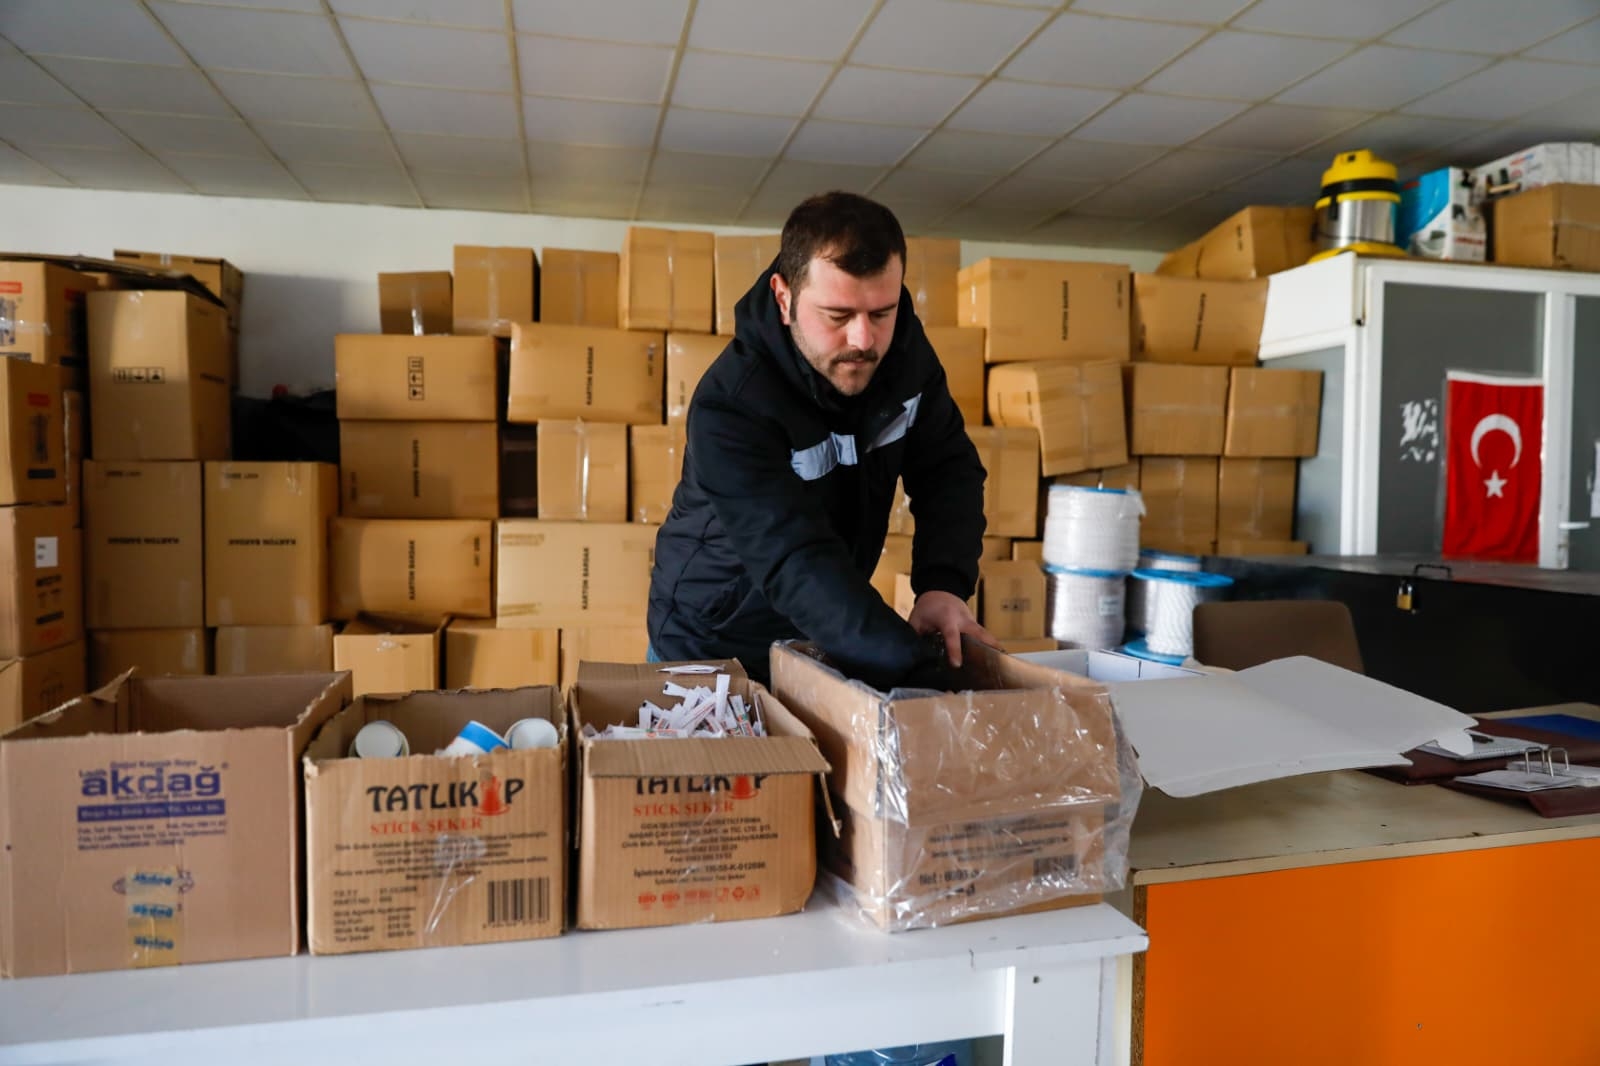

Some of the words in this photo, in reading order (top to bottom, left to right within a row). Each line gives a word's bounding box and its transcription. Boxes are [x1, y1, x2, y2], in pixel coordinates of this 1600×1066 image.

[582, 547, 590, 577] BARDAK
[581, 579, 590, 611] KARTON
[81, 765, 221, 797] akdağ
[366, 777, 524, 813] TATLIKP
